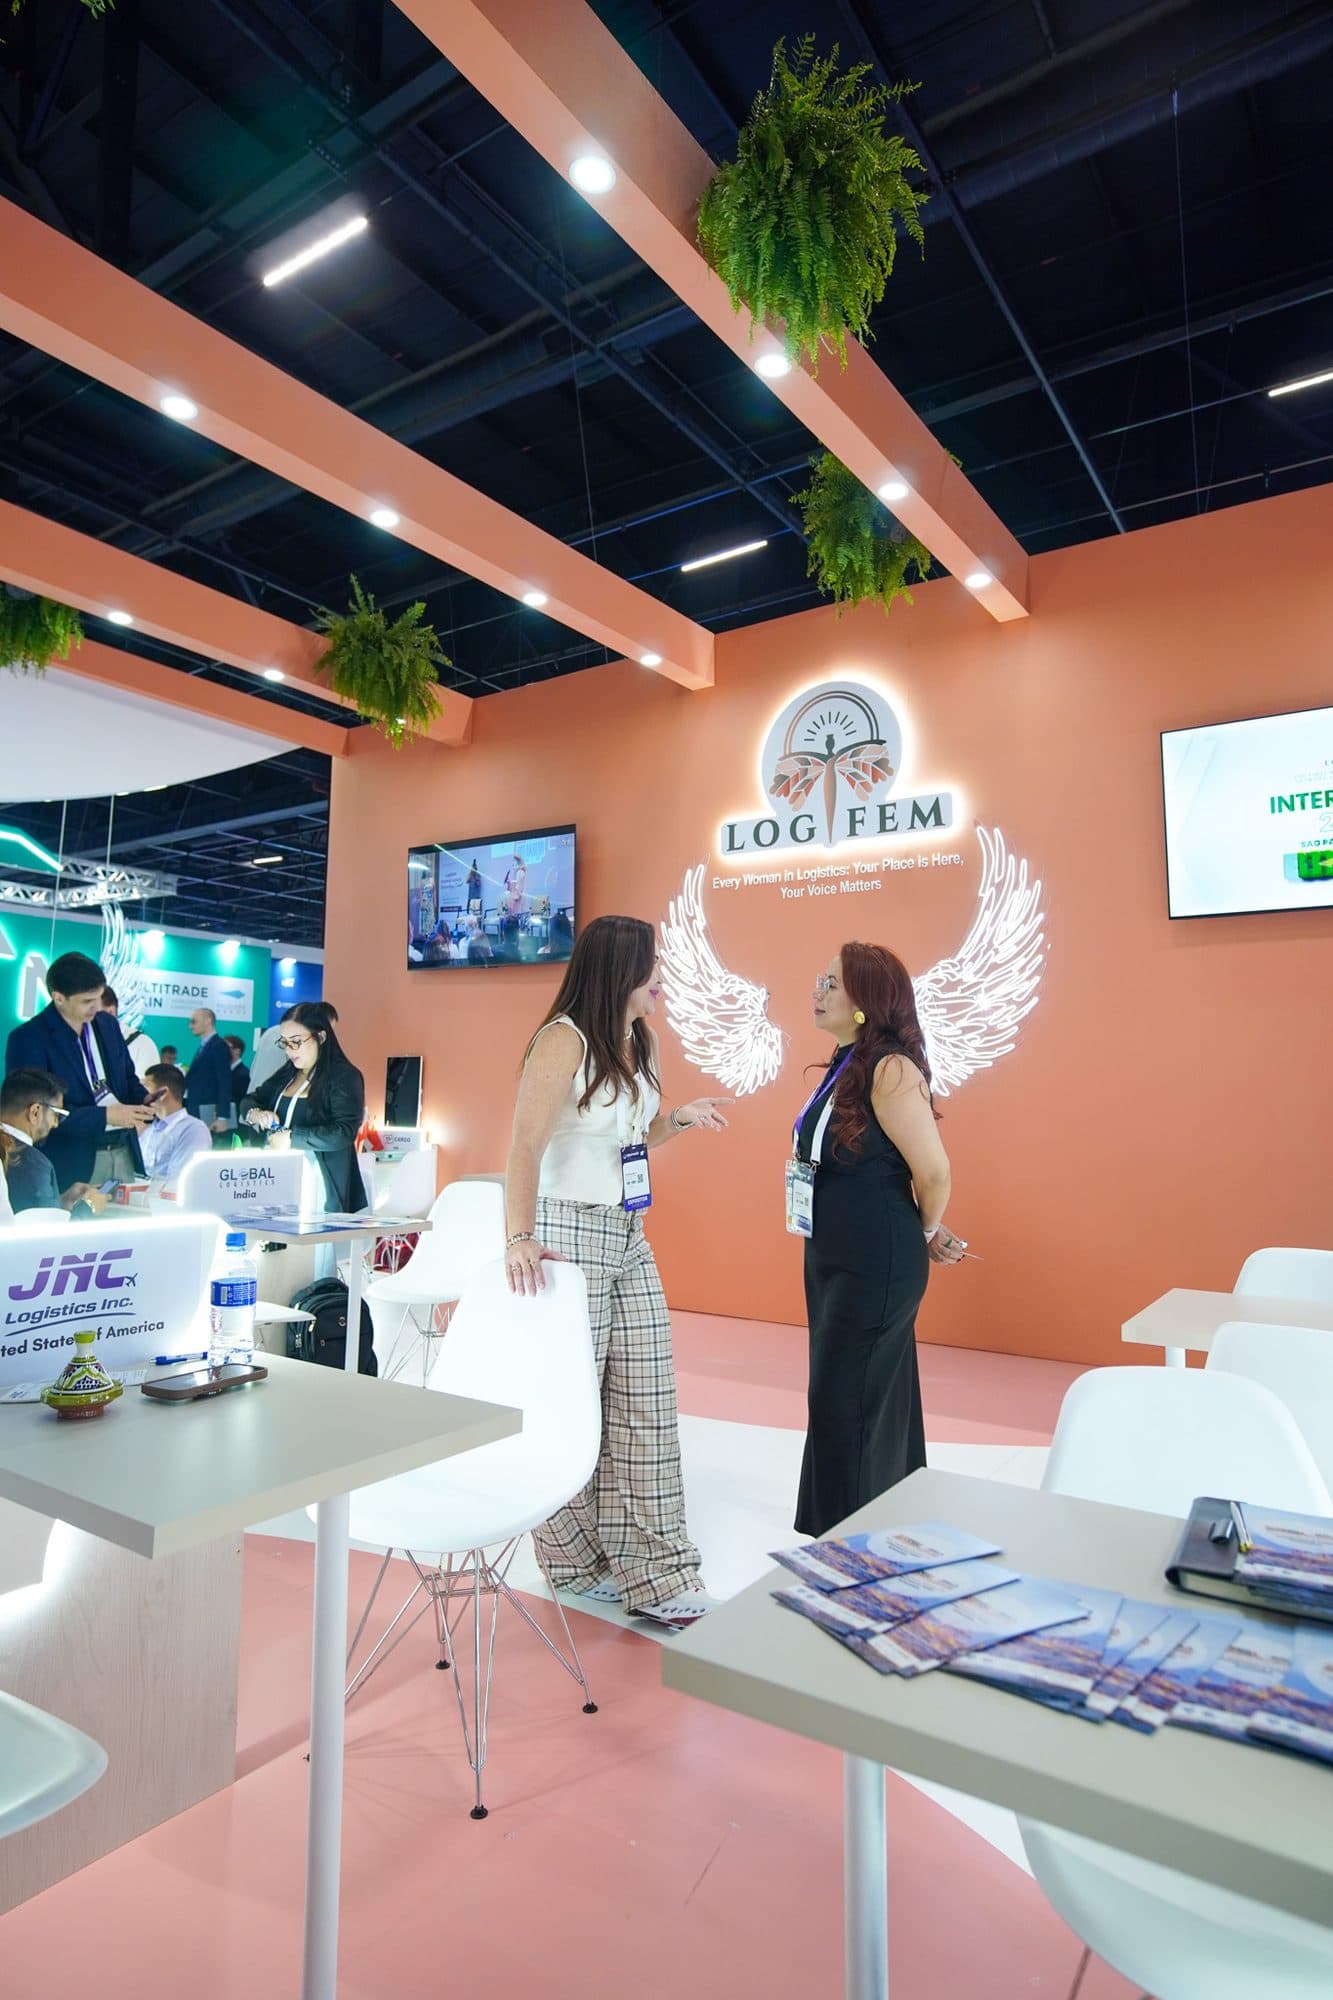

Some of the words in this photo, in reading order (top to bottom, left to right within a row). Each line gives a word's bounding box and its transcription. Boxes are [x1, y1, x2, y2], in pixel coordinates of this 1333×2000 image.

[726, 814, 817, 852] LOG
[847, 796, 946, 837] FEM
[712, 876, 741, 890] Every
[743, 871, 782, 886] Woman
[784, 868, 794, 881] in
[797, 864, 850, 882] Logistics:
[853, 861, 878, 874] Your
[882, 857, 914, 871] Place
[918, 855, 929, 868] is
[932, 852, 964, 867] Here,
[780, 887, 804, 900] Your
[807, 883, 837, 897] Voice
[840, 878, 882, 893] Matters
[144, 982, 209, 998] LTITRADE
[233, 1189, 257, 1199] India
[8, 1248, 134, 1301] JNC
[5, 1302, 97, 1324] Logistics
[101, 1296, 134, 1311] Inc.
[32, 1332, 75, 1351] State
[105, 1320, 165, 1340] America
